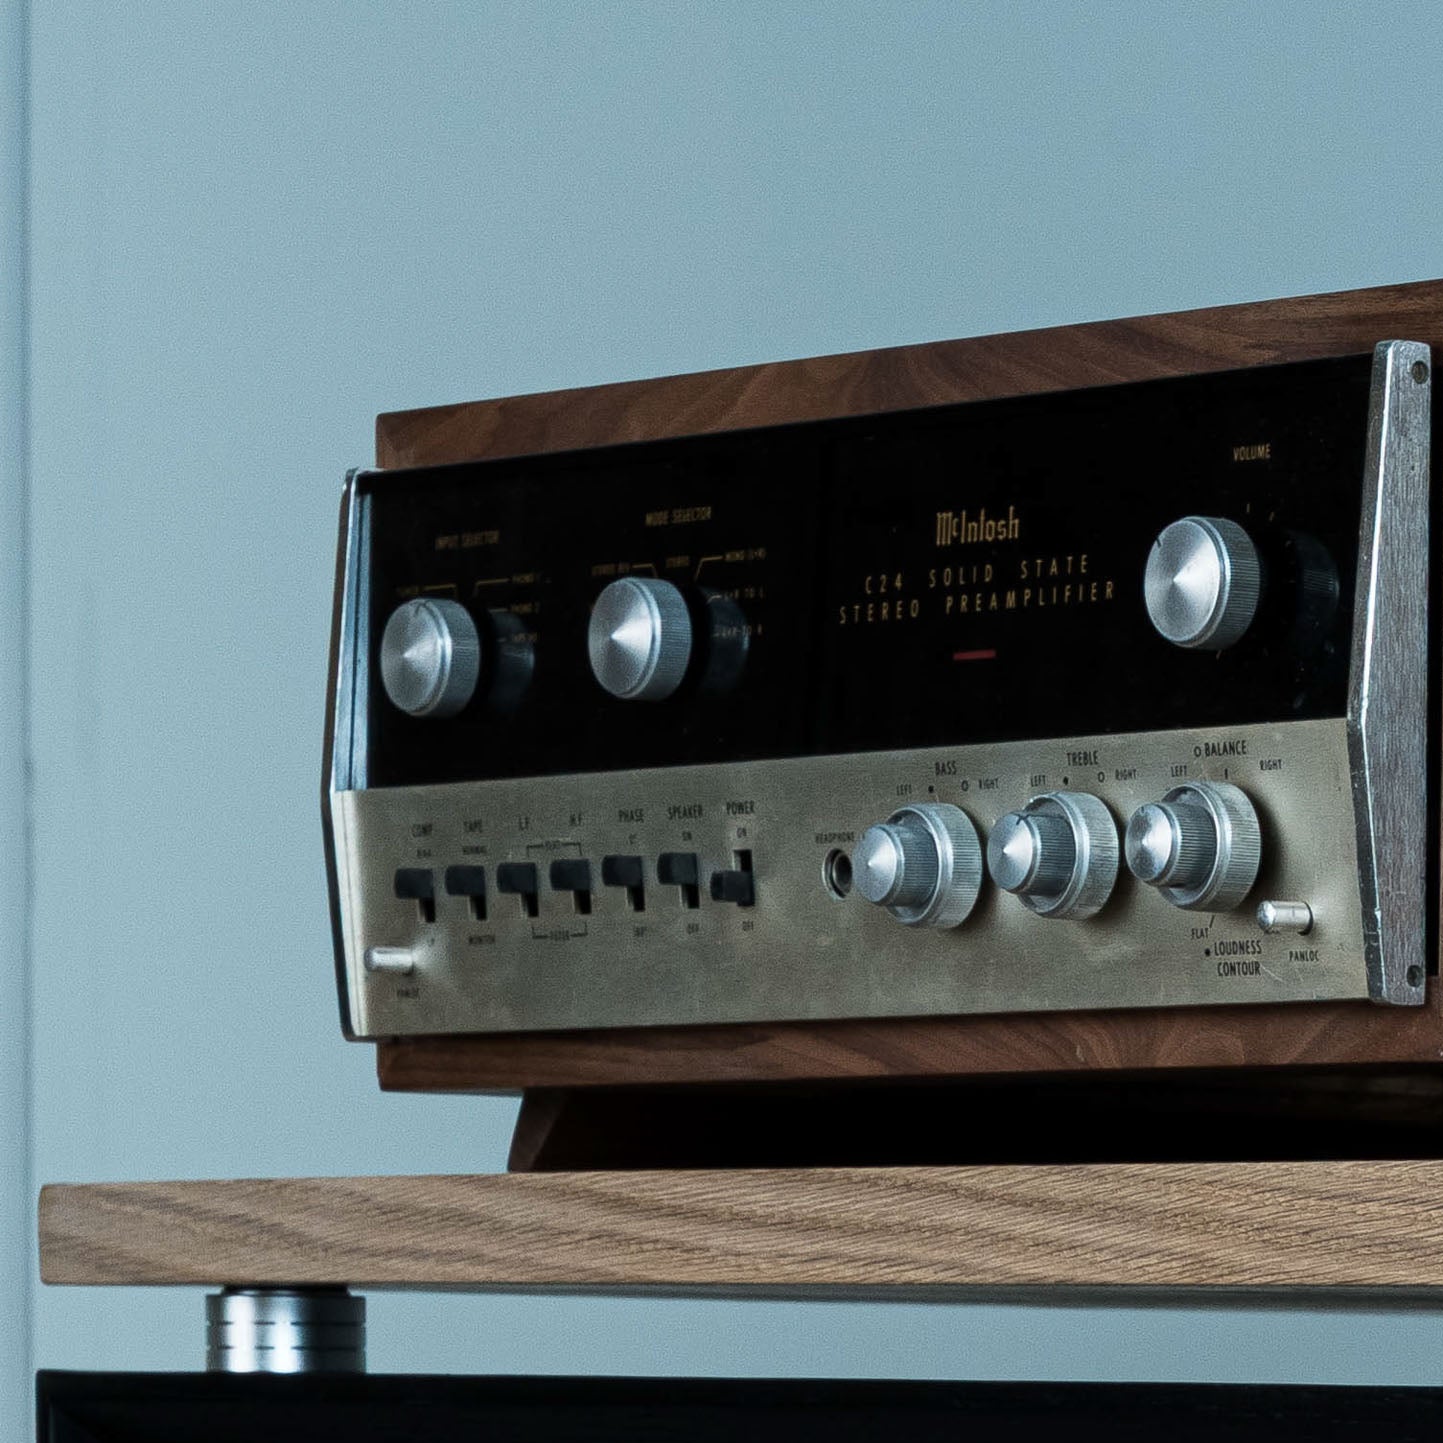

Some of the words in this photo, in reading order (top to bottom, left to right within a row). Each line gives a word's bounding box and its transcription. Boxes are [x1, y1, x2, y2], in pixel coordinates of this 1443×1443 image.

[1232, 442, 1272, 463] VOLUME
[671, 505, 712, 524] SELECTOR
[936, 505, 1020, 548] McIntosh
[928, 564, 994, 589] SOLID
[1019, 553, 1089, 580] STATE
[839, 598, 920, 625] STEREO
[944, 580, 1115, 616] PREAMPLIFIER
[1203, 740, 1248, 758] BALANCE
[1067, 750, 1099, 767] TREBLE
[935, 760, 957, 776] BASS
[1170, 764, 1188, 778] LEFT
[1259, 758, 1283, 772] RIGHT
[896, 783, 913, 796] LEFT
[979, 777, 999, 790] RIGHT
[1030, 774, 1047, 788] LEFT
[1115, 768, 1138, 781] RIGHT
[617, 808, 645, 823] PHASE
[667, 803, 703, 821] SPEAKER
[725, 800, 755, 816] POWER
[1190, 927, 1210, 941] FLAT
[1213, 939, 1263, 957] LOUDNESS
[1288, 949, 1320, 962] PANLOC
[1216, 960, 1262, 977] CONTOUR
